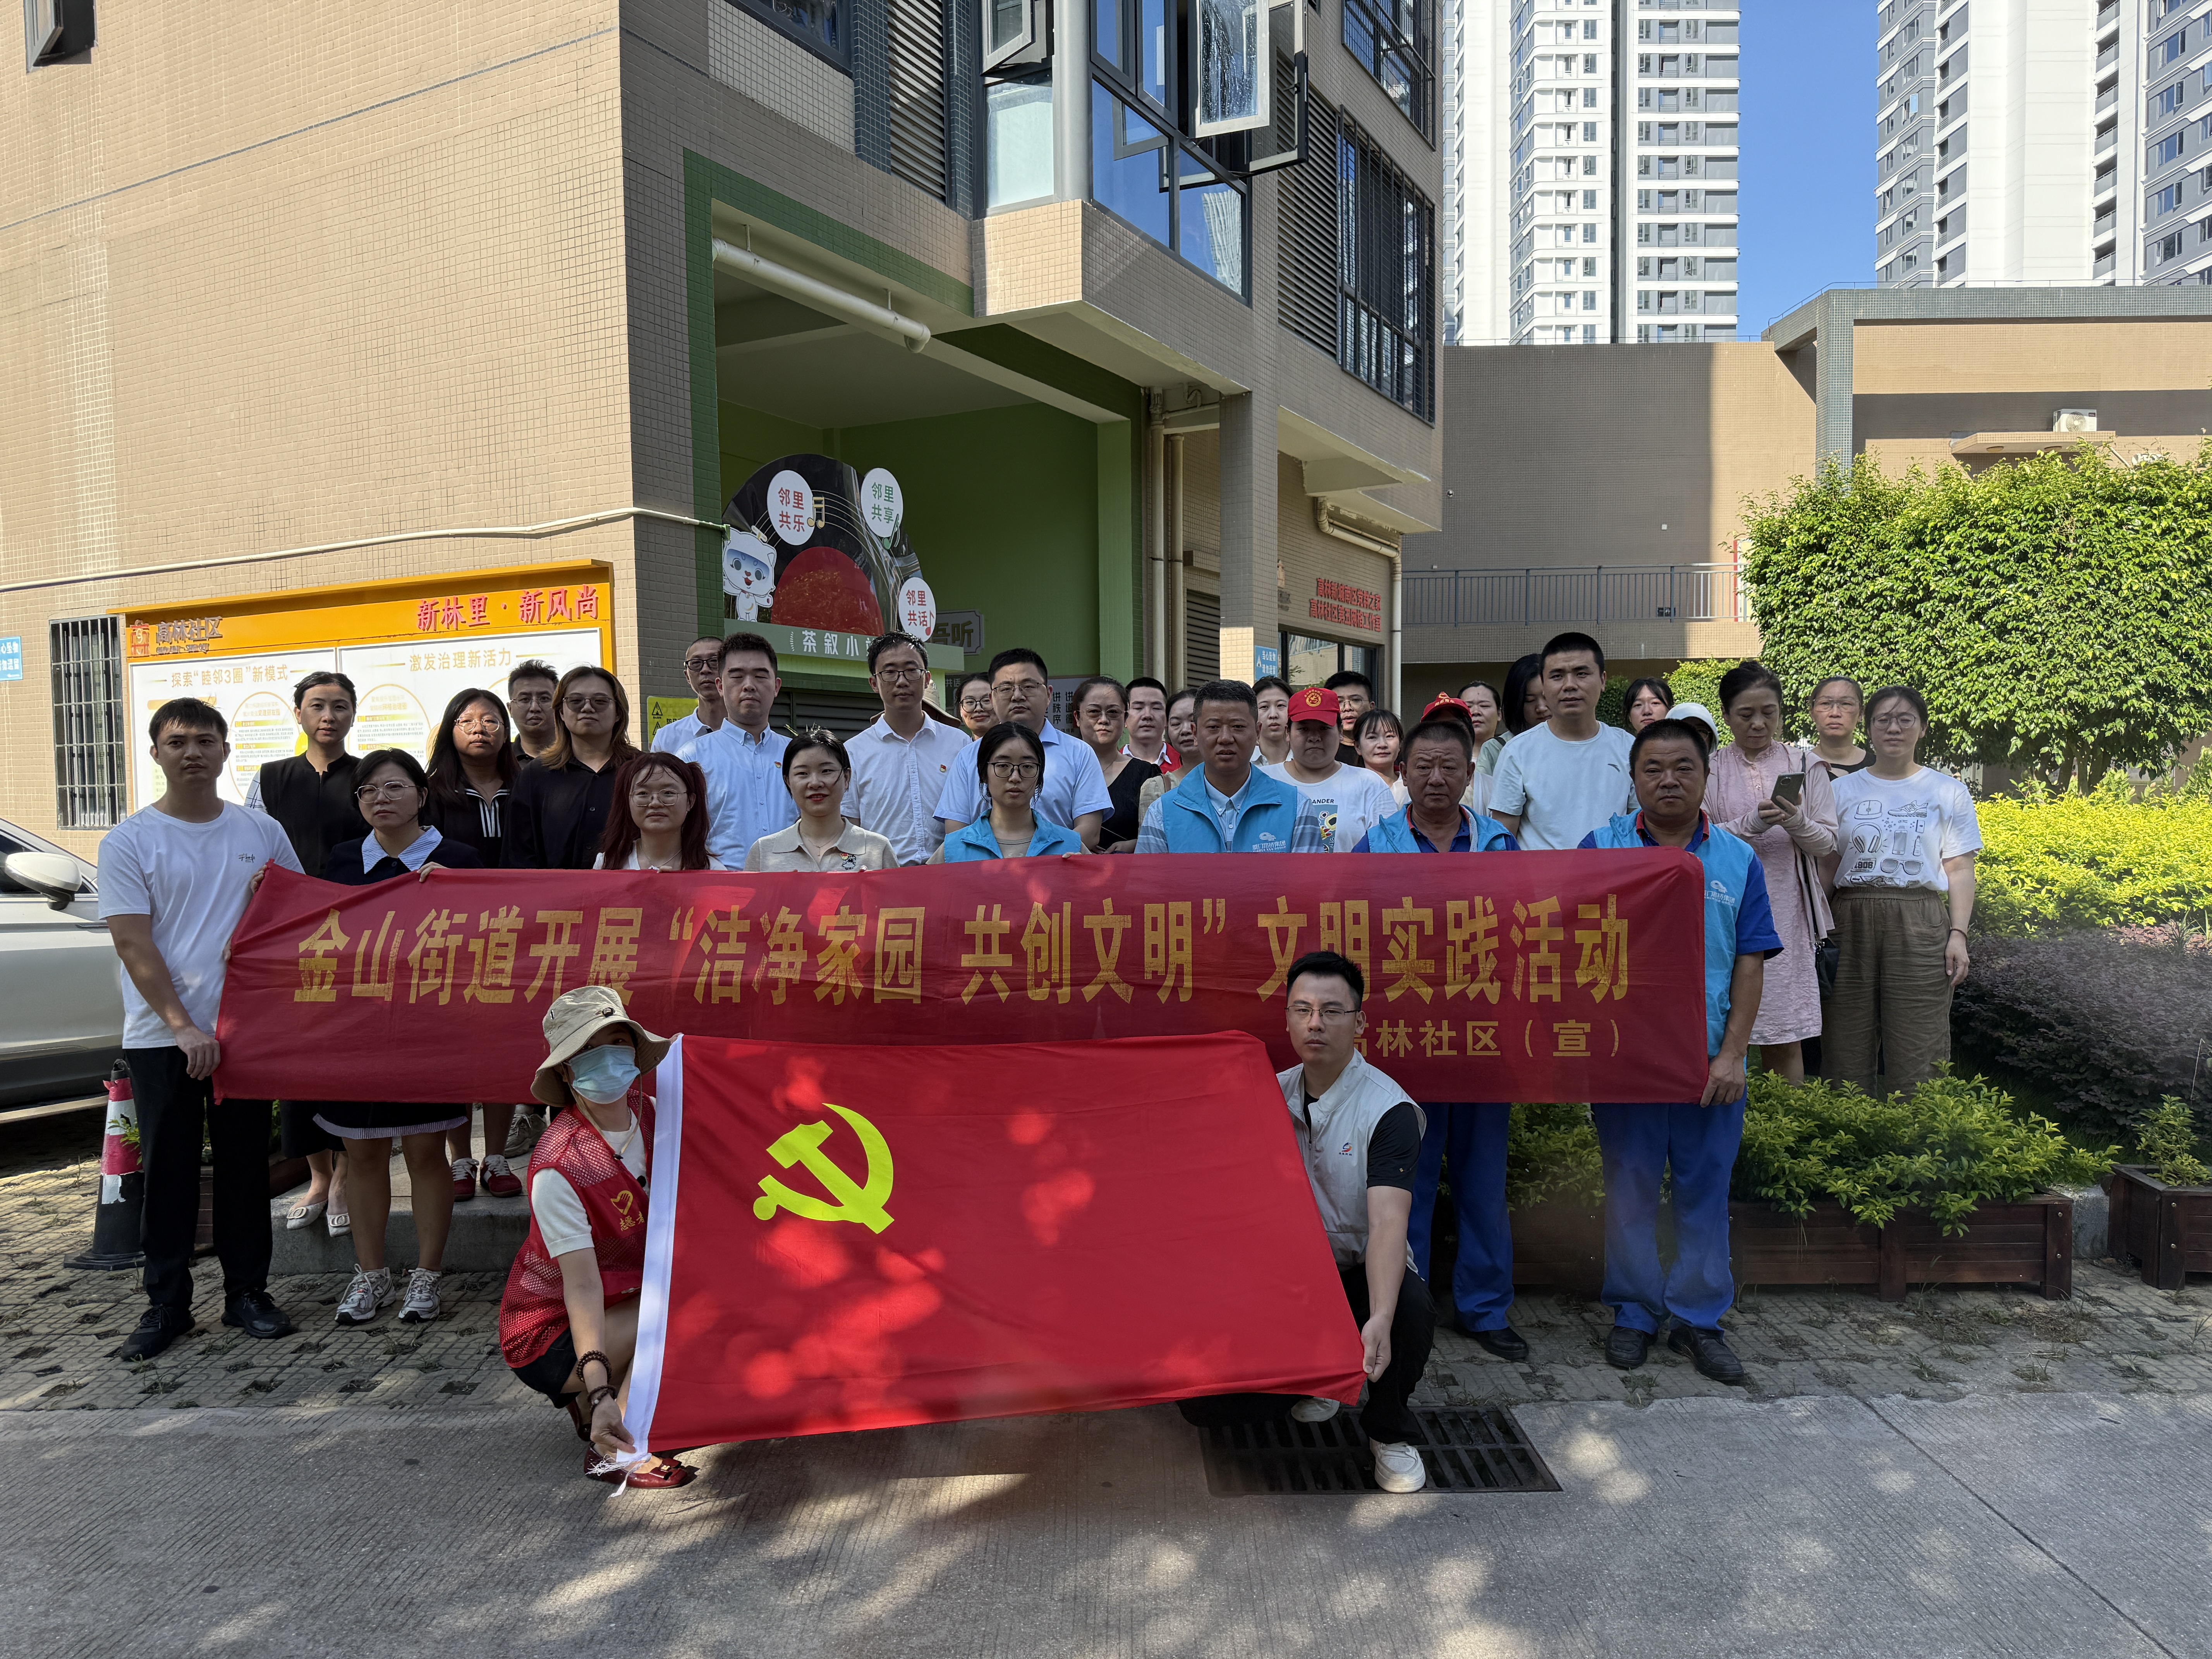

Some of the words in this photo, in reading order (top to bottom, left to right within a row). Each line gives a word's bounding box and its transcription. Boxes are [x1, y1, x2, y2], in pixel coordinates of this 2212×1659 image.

[778, 487, 804, 510] 邻里
[871, 482, 894, 503] 邻里
[778, 510, 805, 532] 共乐
[871, 503, 894, 524] 共享
[906, 589, 927, 607] 邻里
[907, 610, 928, 627] 共话
[156, 616, 223, 644] 高林社区
[410, 647, 511, 672] 激发治理新活力
[171, 665, 288, 688] 探索“睦邻3圈”新模式
[1053, 692, 1061, 724] 讲秩序
[1705, 890, 1735, 904] 门路桥集团
[620, 1211, 644, 1231] 志愿者
